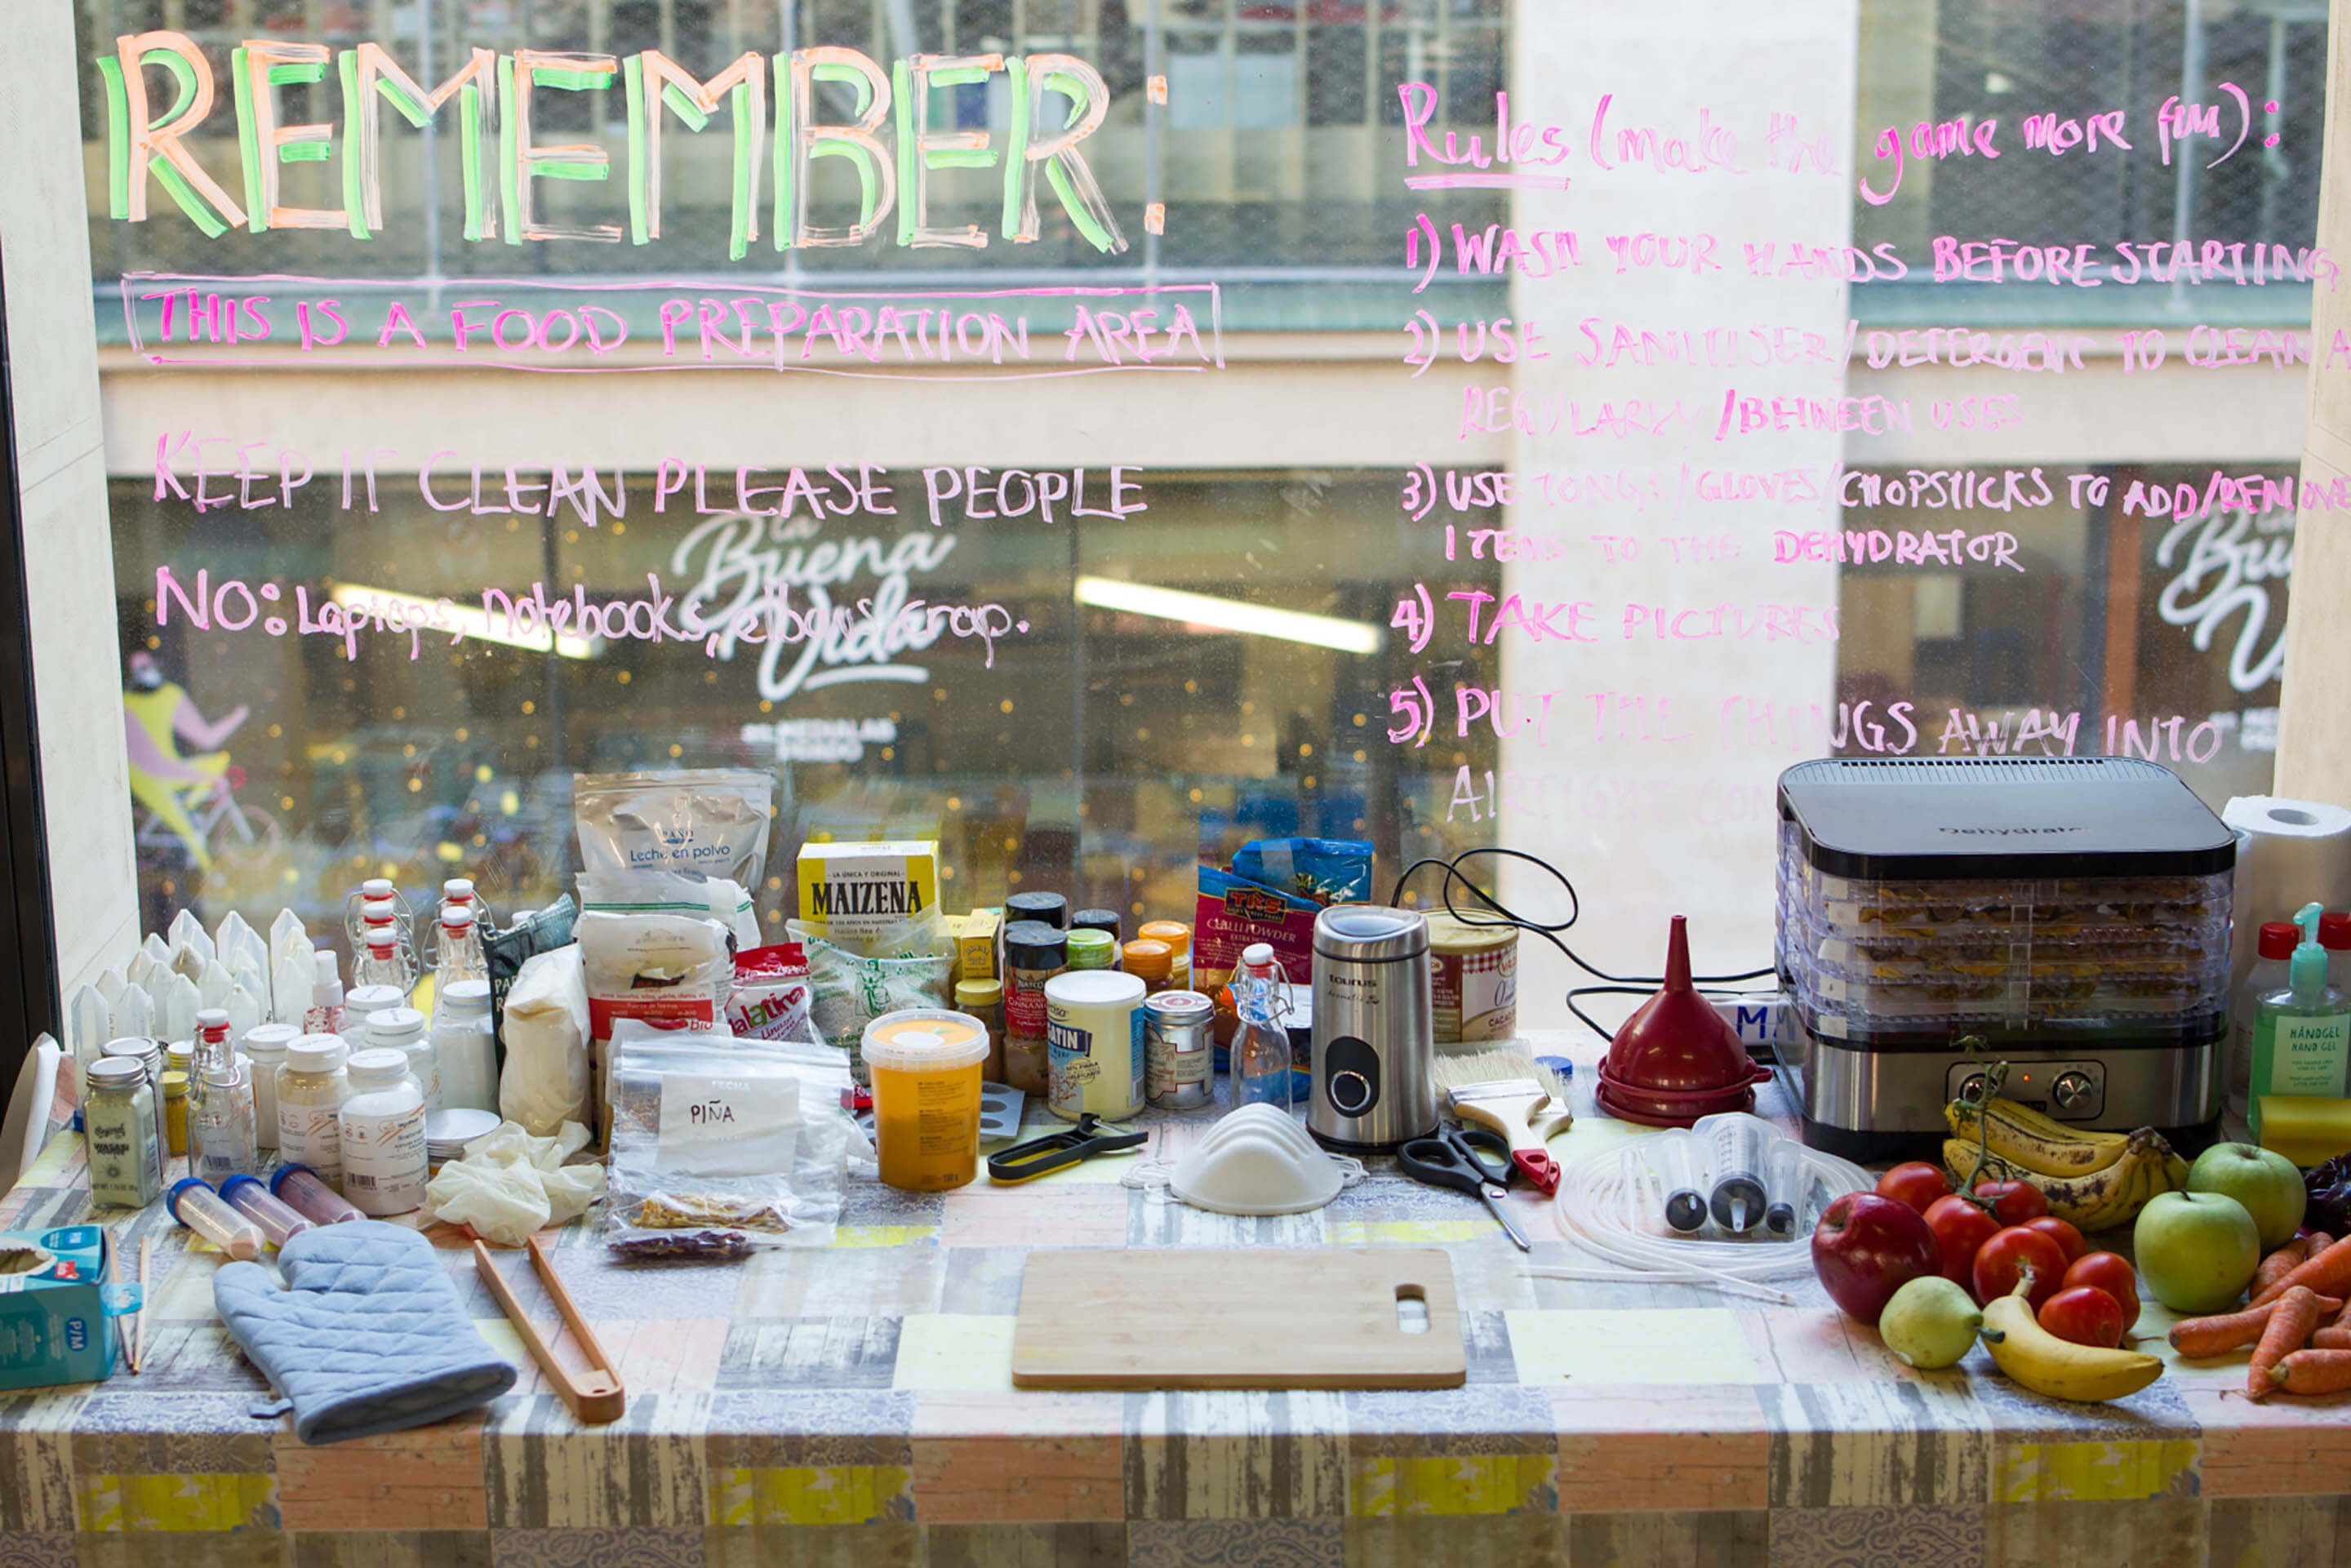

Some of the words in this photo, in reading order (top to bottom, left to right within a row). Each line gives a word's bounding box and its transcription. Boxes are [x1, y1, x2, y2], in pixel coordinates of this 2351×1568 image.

[1398, 82, 1571, 169] Rules
[1860, 126, 2000, 206] game
[2024, 113, 2132, 155] more
[1407, 213, 1441, 293] 1)
[1451, 224, 1583, 278] WASH
[1606, 233, 1722, 274] YOUR
[1744, 241, 1908, 282] HANDS
[1933, 236, 2103, 287] BEFORE
[141, 287, 271, 346] THIS
[296, 300, 349, 352] IS
[377, 302, 427, 349] A
[451, 300, 627, 355] FOOD
[660, 298, 1029, 372] PREPARATION
[1064, 304, 1210, 365] AREA
[1403, 309, 1441, 378] 2)
[1458, 318, 1552, 364] USE
[2114, 329, 2166, 374] TO
[2184, 324, 2313, 373] CLEAN
[153, 429, 313, 513] KEEP
[340, 449, 398, 513] IT
[419, 450, 626, 527] CLEAN
[654, 457, 897, 520] PLEASE
[922, 465, 1147, 526] PEOPLE
[1402, 462, 1437, 522] 3)
[1446, 471, 1523, 512] USE
[672, 513, 958, 632] Buena
[1589, 535, 1642, 564] TO
[1773, 530, 2025, 572] DEHYDRATOR
[1390, 584, 1433, 653] 4)
[1447, 589, 1599, 645] TAKE
[1624, 601, 1841, 646] PICTURES
[1387, 676, 1433, 748] 5)
[1456, 688, 1562, 748] PUT
[1584, 690, 1695, 744] THE
[1938, 708, 2081, 757] AWAY
[2106, 713, 2224, 764] INTO
[672, 849, 689, 859] en
[692, 845, 731, 860] polvo
[811, 882, 922, 915] MAIZENA
[1230, 891, 1282, 913] TRS
[1245, 923, 1296, 943] POWDER
[691, 1099, 735, 1124] PIÑA
